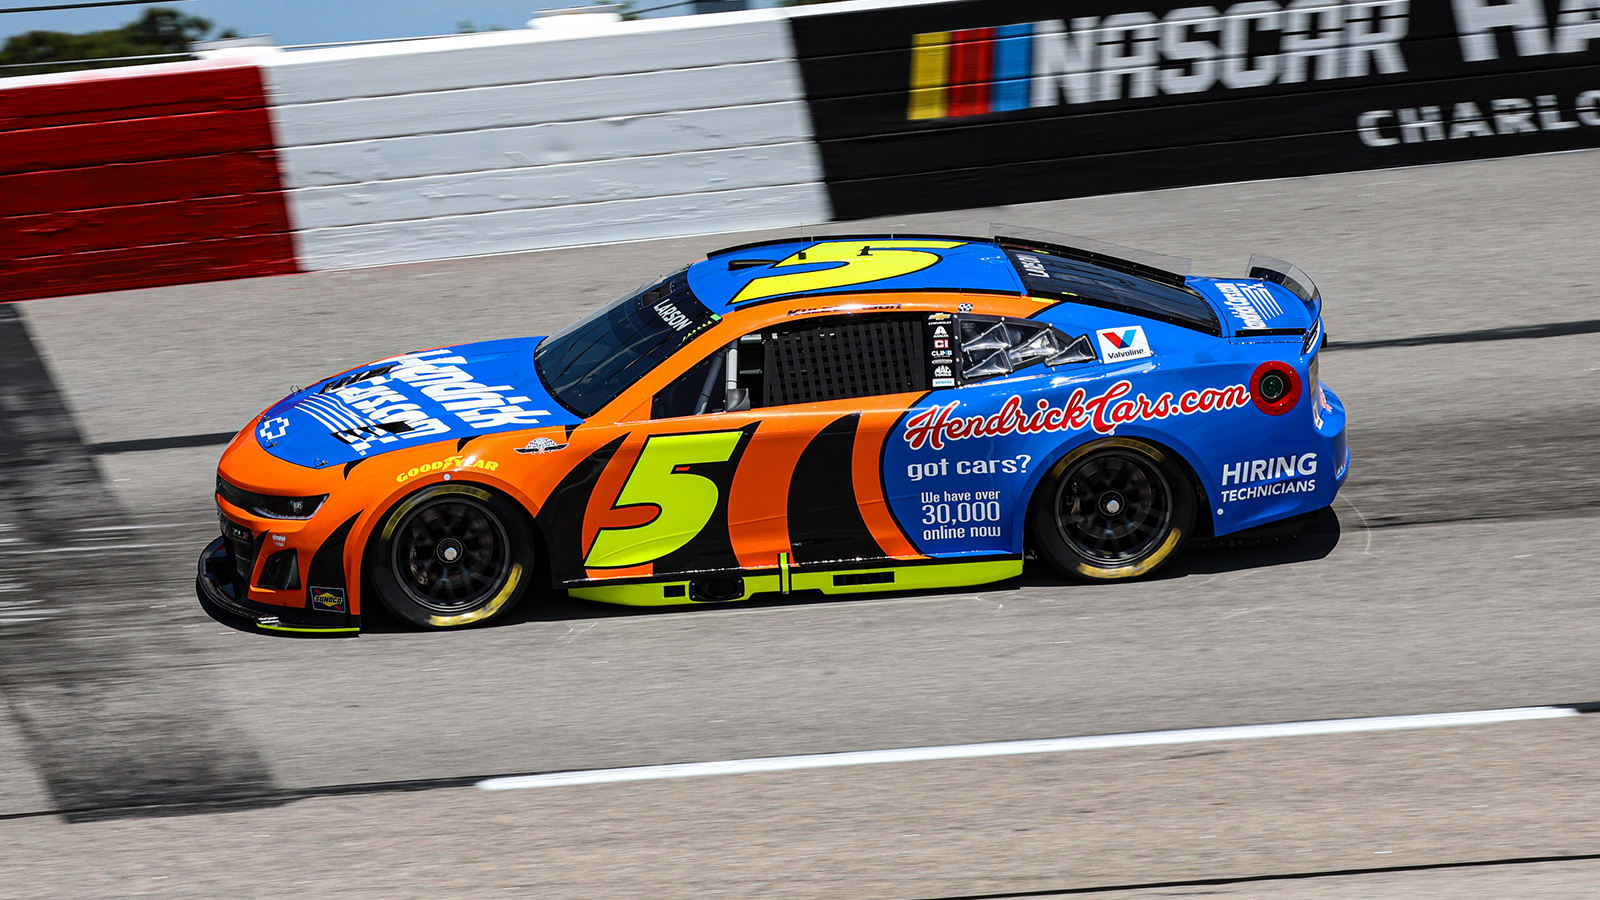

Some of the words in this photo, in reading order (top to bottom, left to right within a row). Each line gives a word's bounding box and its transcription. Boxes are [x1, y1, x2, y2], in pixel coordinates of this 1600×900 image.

[1030, 0, 1409, 107] NASCAR
[653, 298, 693, 331] LARSON
[1107, 348, 1144, 359] Valvoline
[368, 349, 553, 429] Hendrick
[903, 380, 1250, 450] HendrickCars.com
[907, 458, 949, 481] got
[956, 454, 1031, 474] cars?
[1222, 452, 1317, 486] HIRING
[583, 431, 743, 568] 5
[921, 492, 940, 503] We
[944, 490, 971, 502] have
[975, 490, 1001, 500] over
[1221, 479, 1316, 503] TECHNICIANS
[922, 501, 1001, 525] 30,000
[923, 525, 966, 541] online
[970, 526, 1001, 538] now
[314, 595, 343, 605] SUNOCO
